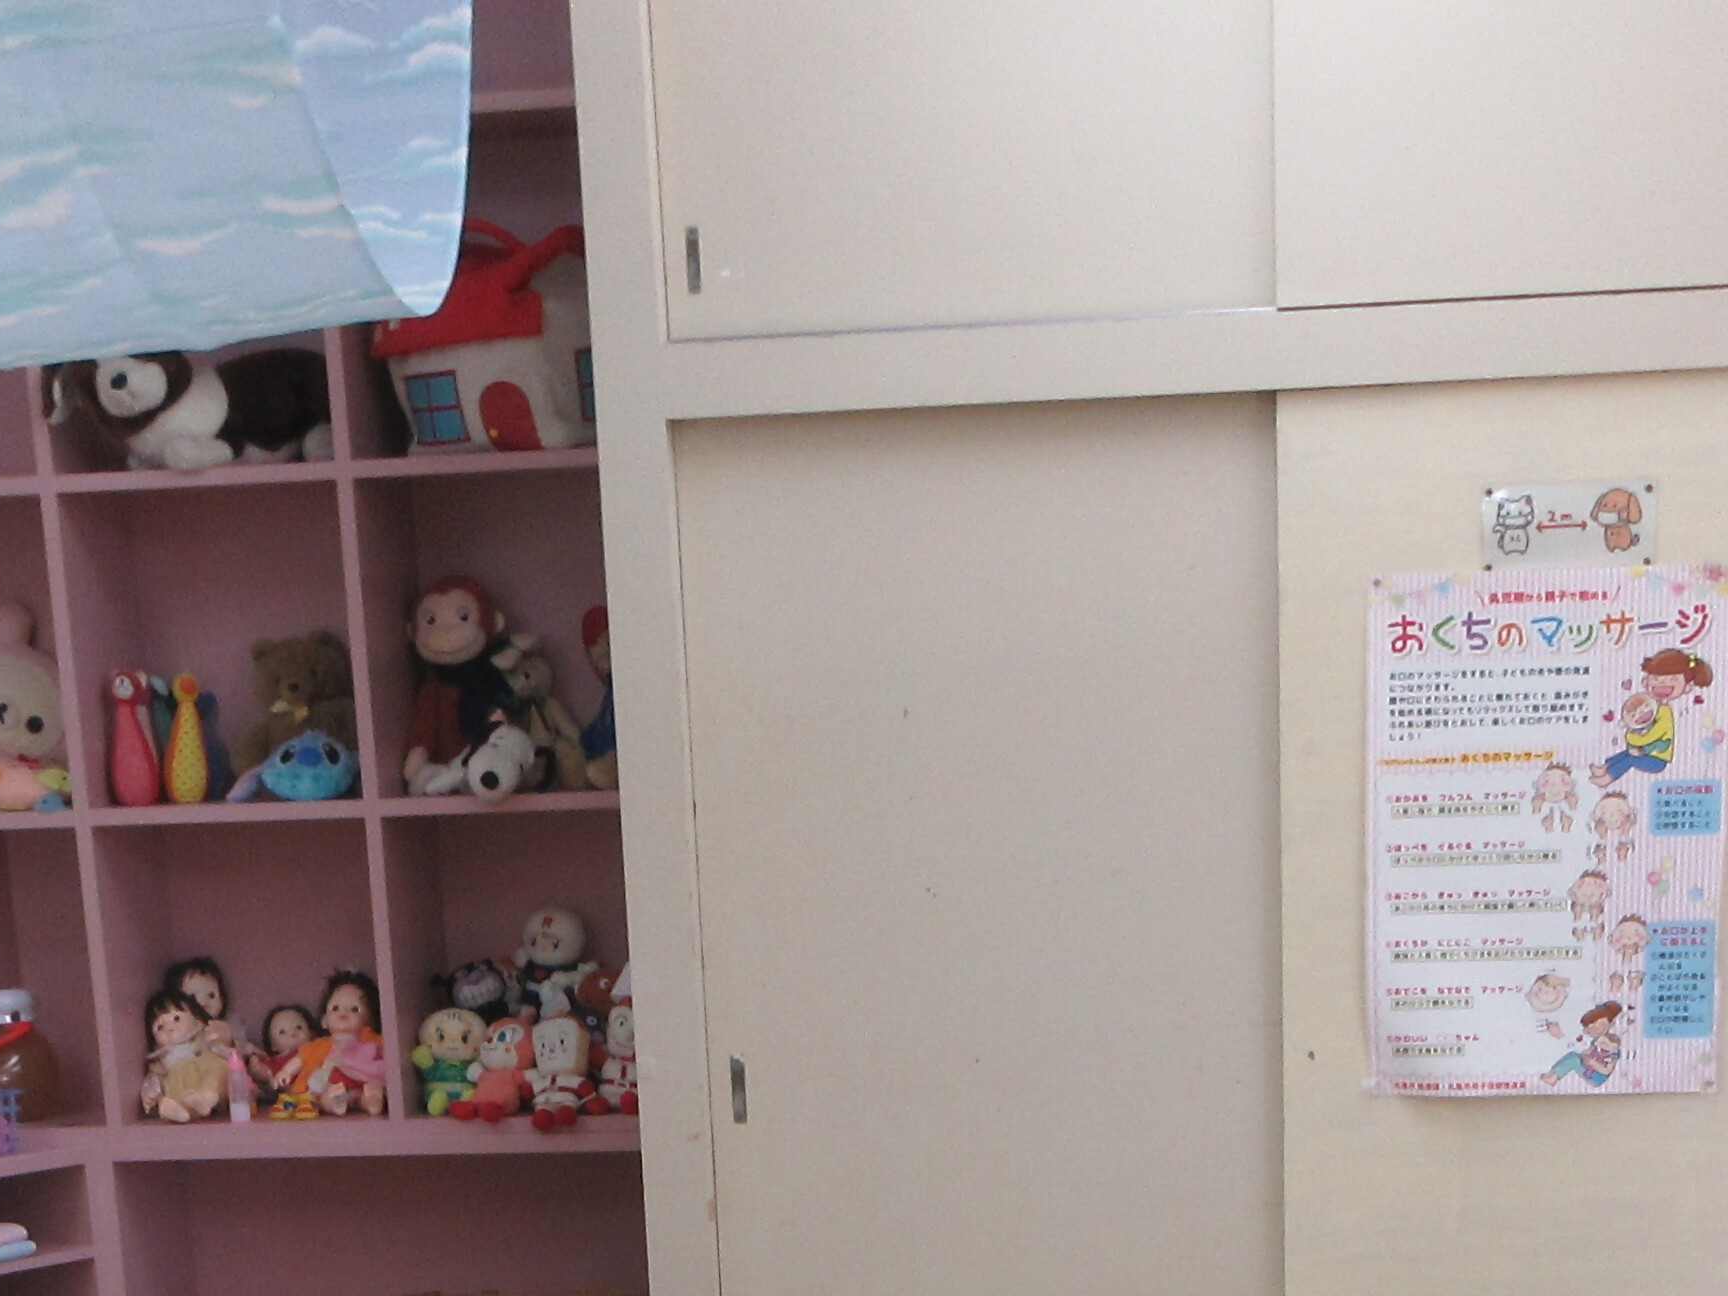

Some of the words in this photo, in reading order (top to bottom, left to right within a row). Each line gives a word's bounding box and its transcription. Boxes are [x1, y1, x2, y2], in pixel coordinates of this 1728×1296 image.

[1388, 604, 1710, 654] おくちのマッサージ
[1461, 751, 1554, 763] おくちのマッサージ
